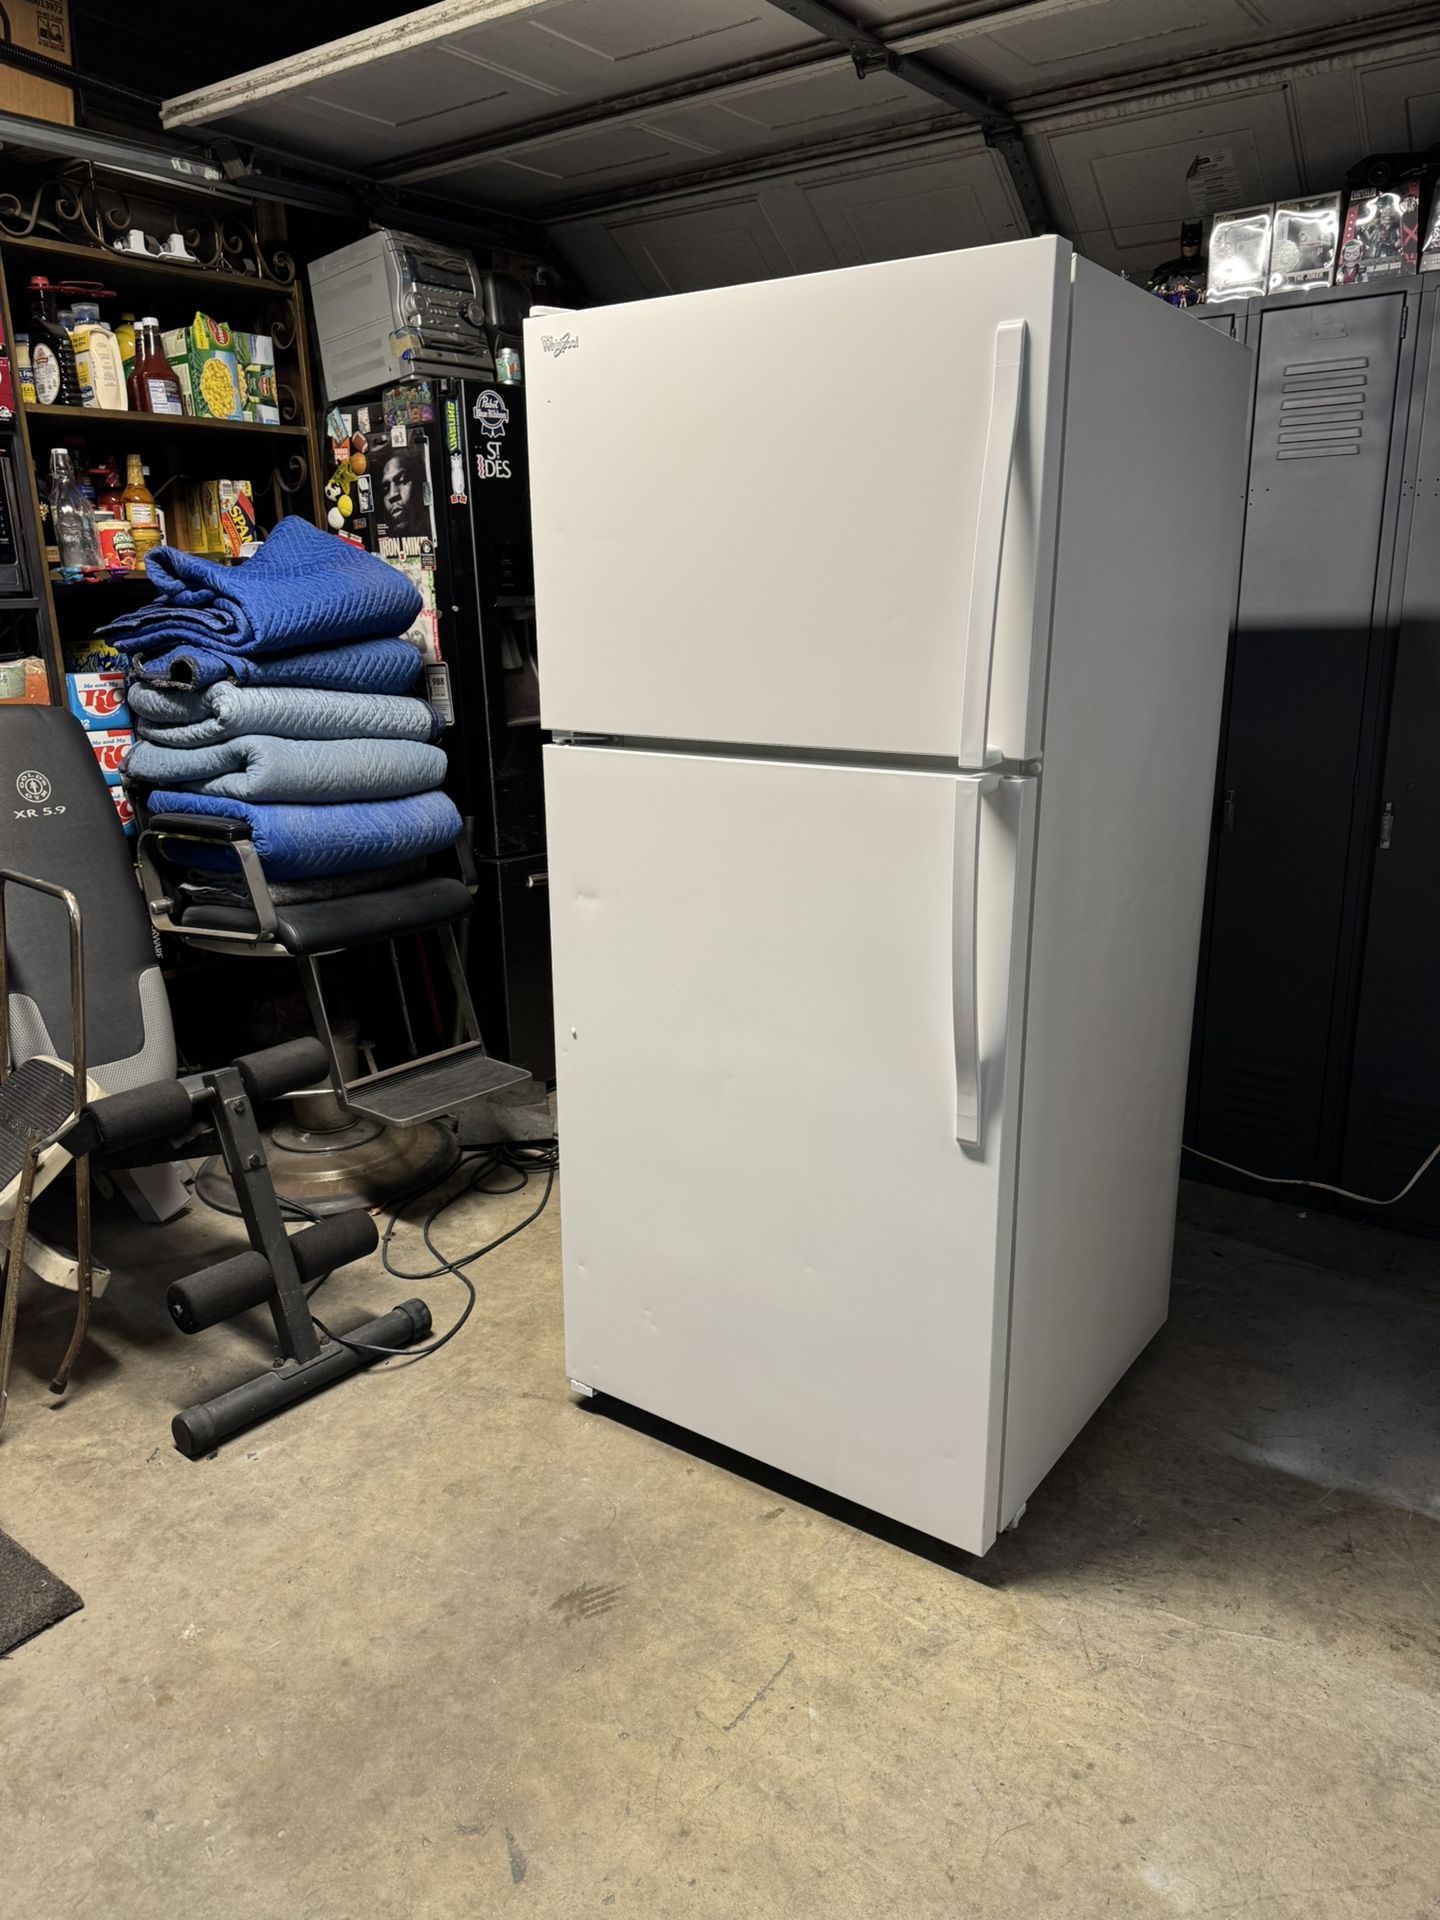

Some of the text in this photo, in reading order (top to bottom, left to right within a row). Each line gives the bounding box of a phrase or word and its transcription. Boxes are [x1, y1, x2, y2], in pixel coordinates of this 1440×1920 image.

[541, 332, 579, 358] Whirlpool
[481, 395, 499, 409] Pabst
[447, 400, 457, 451] UNSUNG
[379, 537, 400, 557] IRON
[431, 677, 445, 686] 988
[78, 688, 124, 714] RC
[93, 744, 131, 769] RC
[13, 805, 66, 819] XR 5.9
